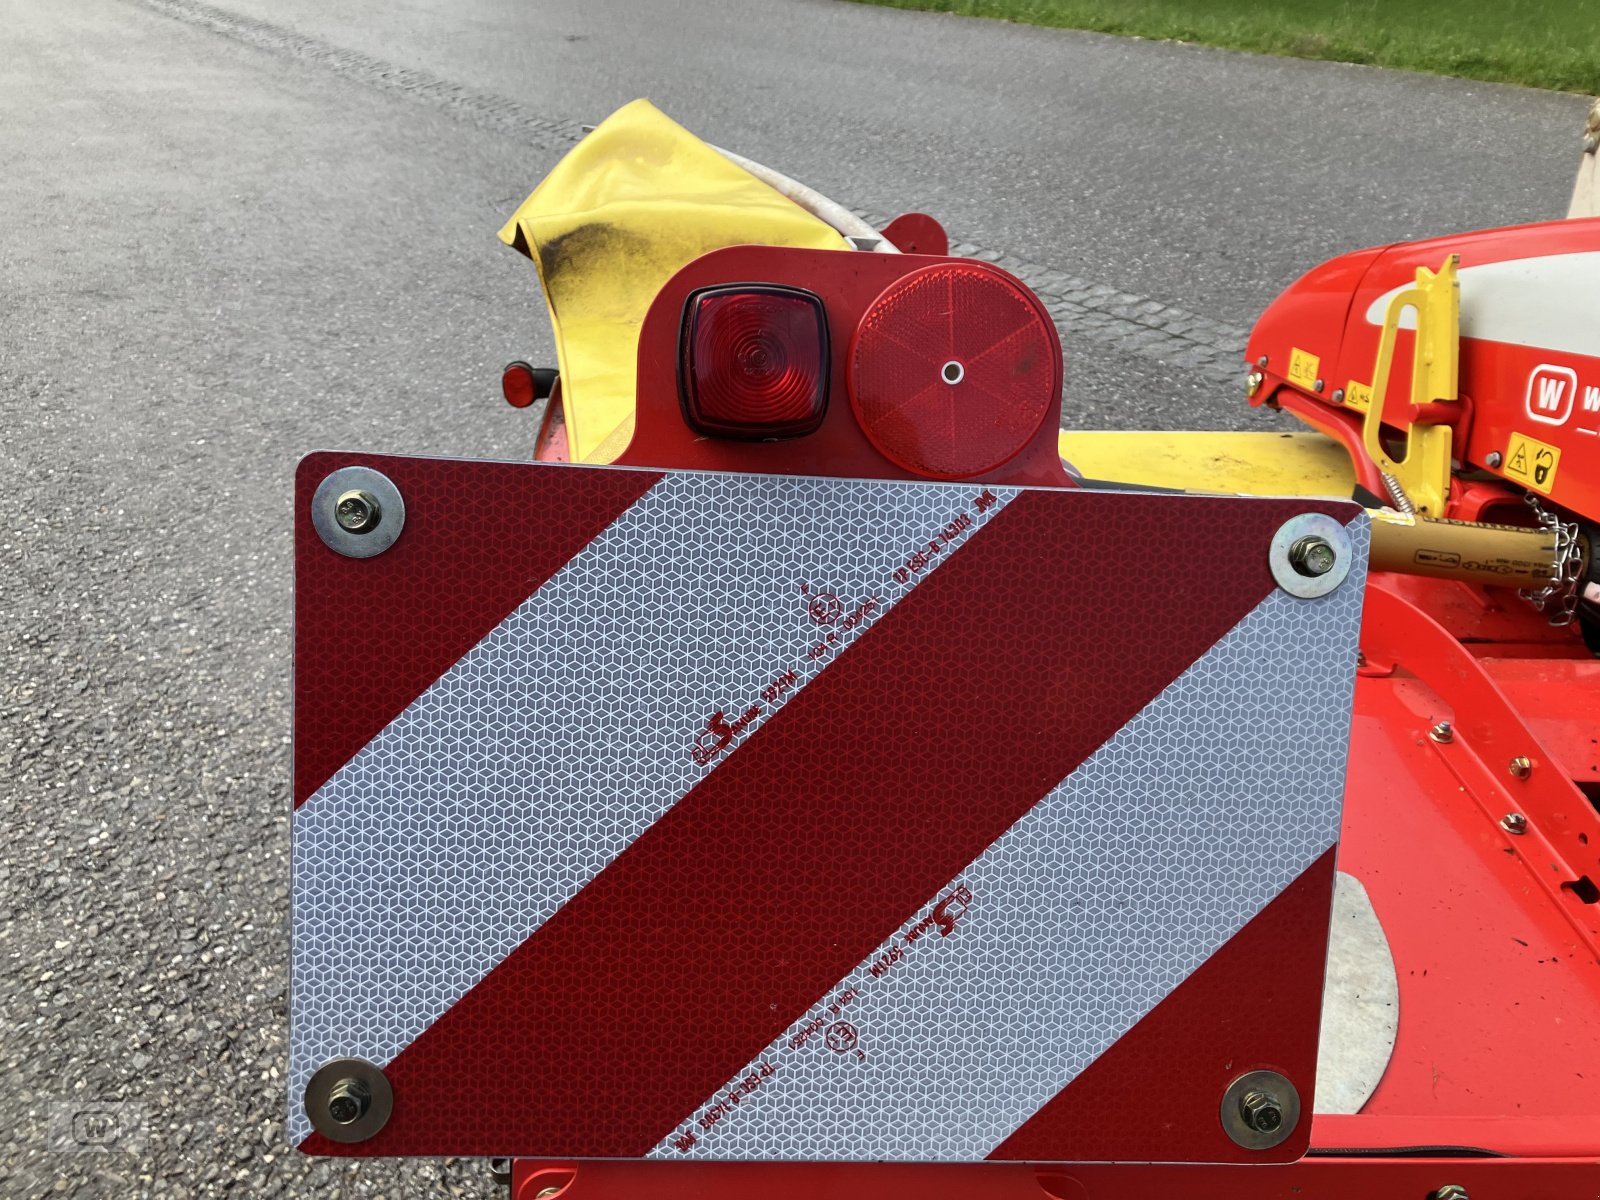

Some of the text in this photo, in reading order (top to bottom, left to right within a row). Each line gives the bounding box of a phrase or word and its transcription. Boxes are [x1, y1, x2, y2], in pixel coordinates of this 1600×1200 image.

[1538, 377, 1567, 411] W
[892, 567, 910, 585] TP
[807, 641, 828, 661] 104
[826, 632, 838, 644] R
[841, 594, 881, 631] 004251
[760, 669, 798, 704] 5921M
[867, 944, 904, 978] 5921M
[827, 1002, 839, 1014] R
[837, 986, 858, 1006] 104
[786, 1016, 825, 1051] 004251
[757, 1060, 774, 1077] TP
